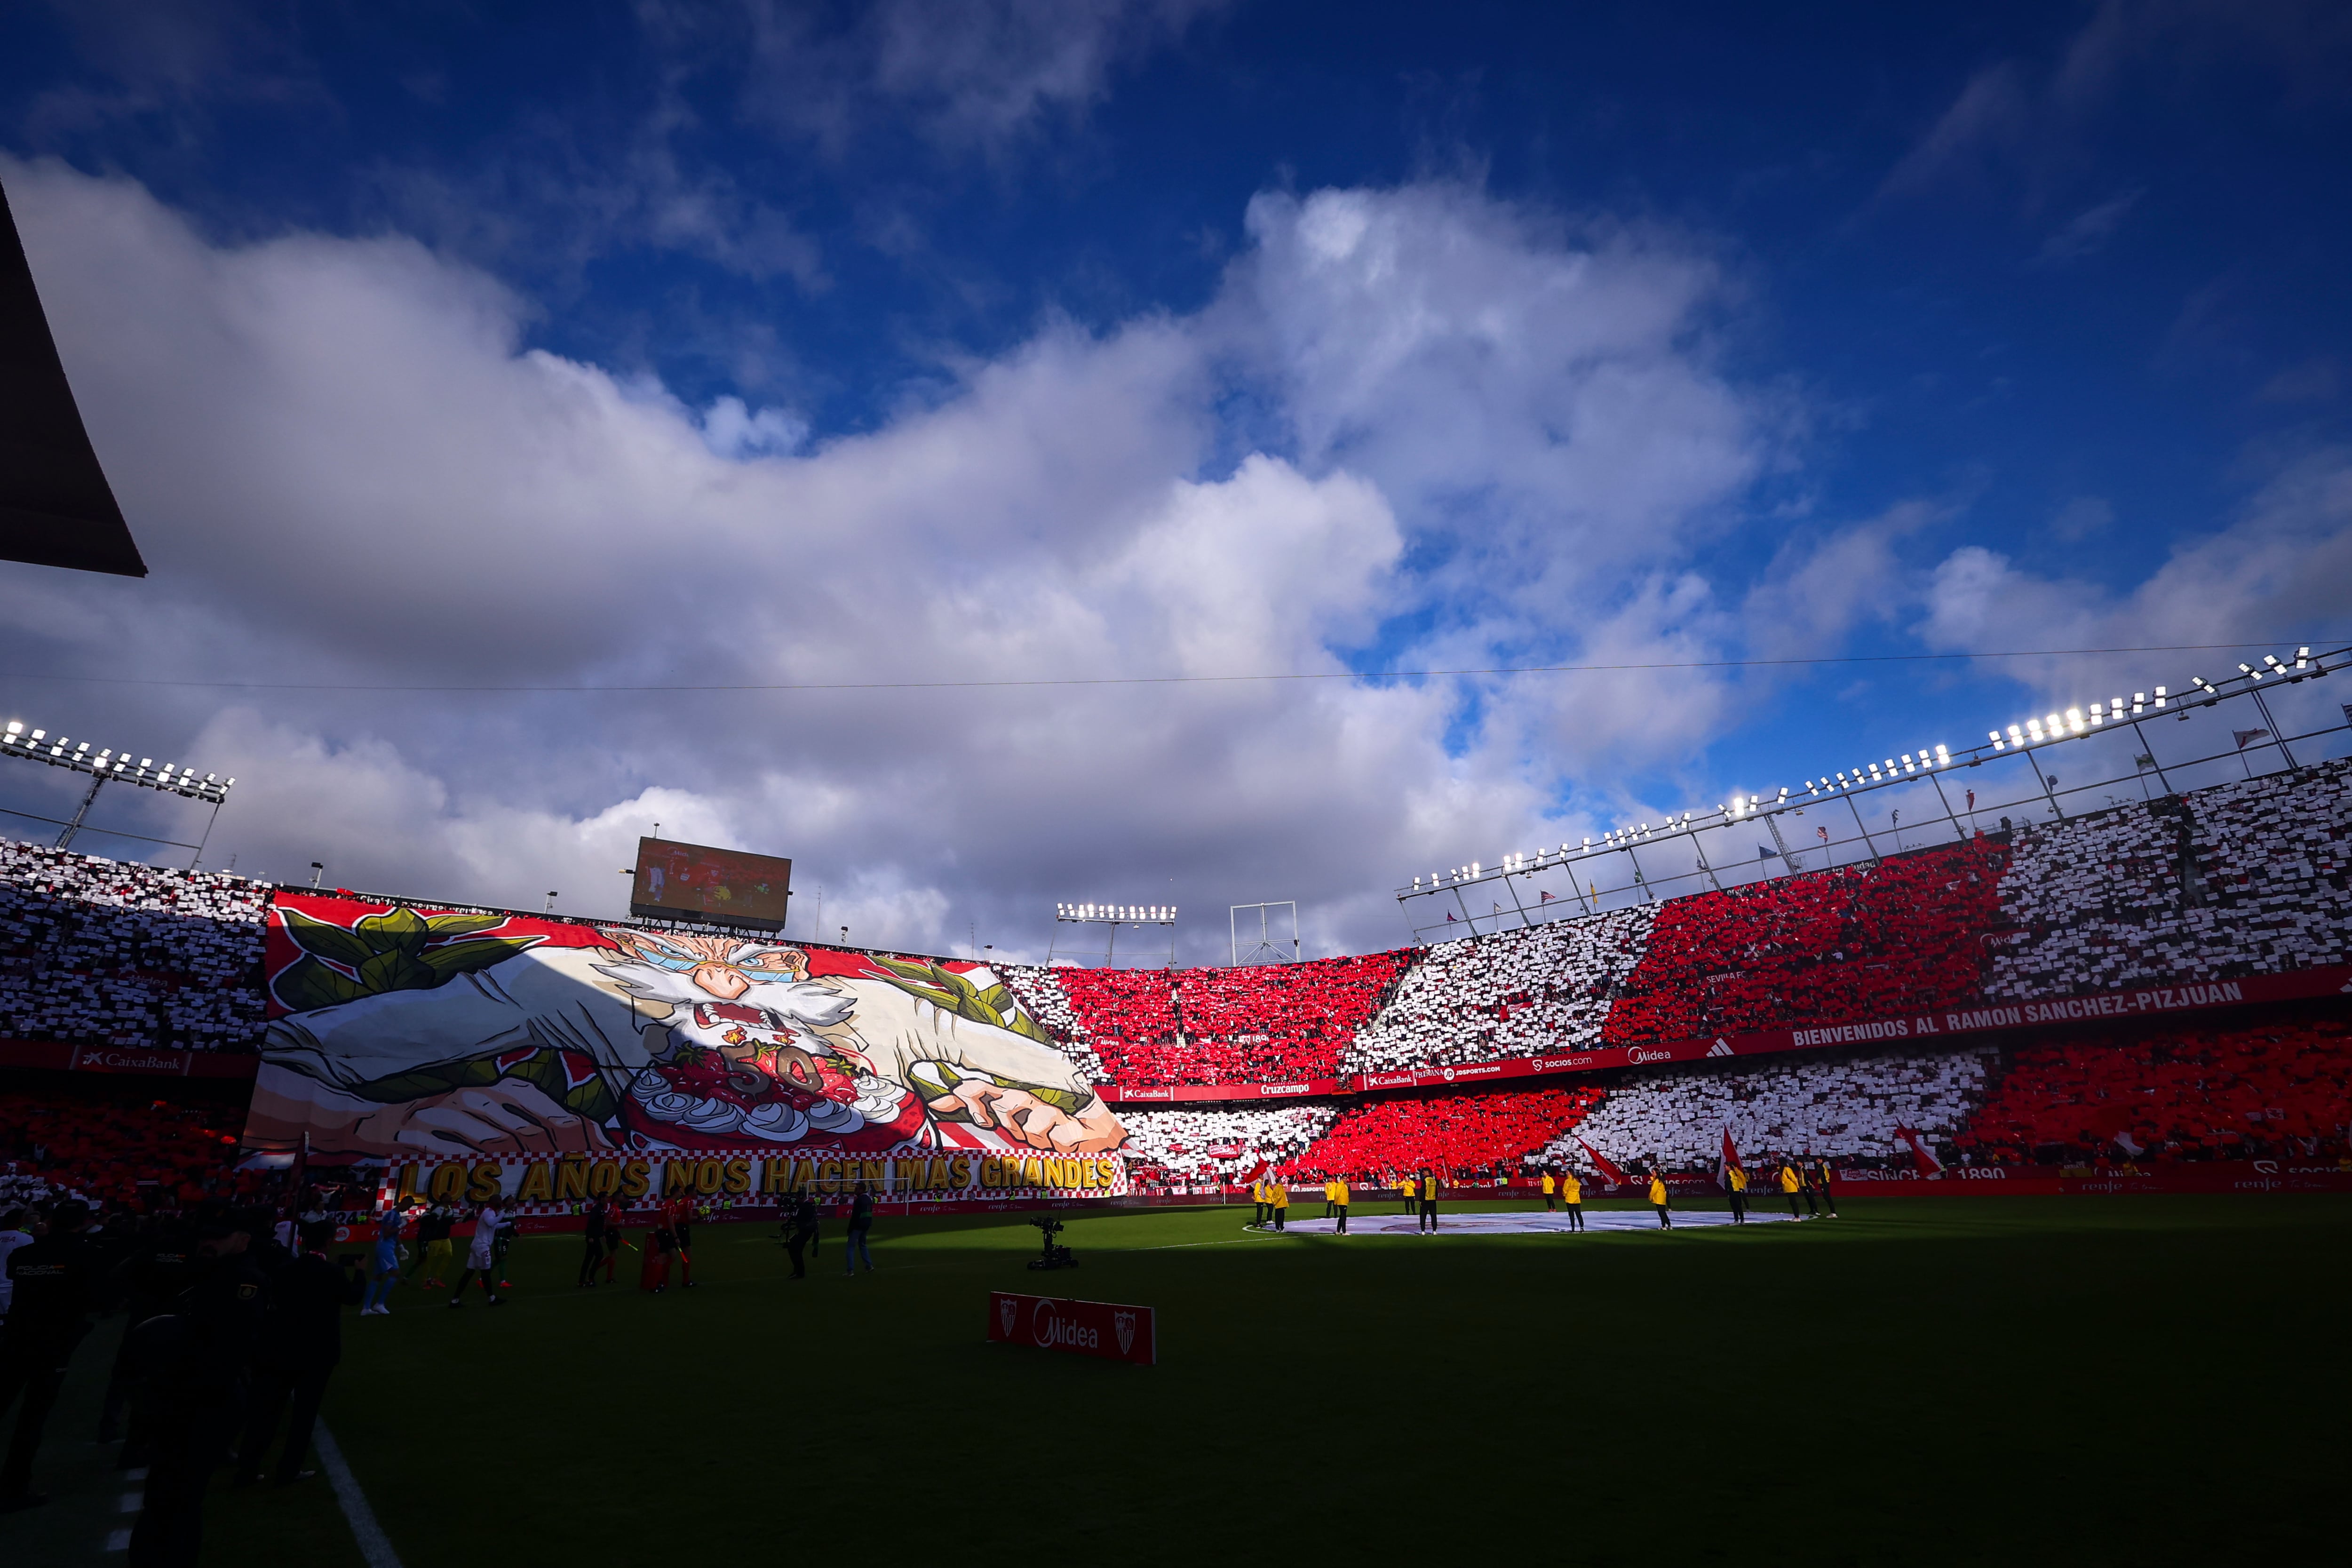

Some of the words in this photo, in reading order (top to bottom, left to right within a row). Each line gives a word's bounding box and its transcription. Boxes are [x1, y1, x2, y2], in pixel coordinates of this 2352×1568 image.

[1849, 859, 1875, 870] iudad
[1792, 1019, 1908, 1046] BIENVENIDOS
[1916, 1017, 1939, 1034] AL
[1946, 1007, 2022, 1031] RAMON
[2024, 982, 2242, 1023] SANCHEZ-PIZJUAN
[105, 1053, 180, 1069] CaixaBank
[1628, 1049, 1671, 1063] Midea
[1545, 1057, 1592, 1068] socios.com
[1455, 1066, 1500, 1076] JDSPORTS.COM
[1379, 1075, 1412, 1085] CaixaBank
[1261, 1084, 1309, 1094] Cruzcampo
[397, 1161, 502, 1205] LOS
[518, 1152, 651, 1202] AÑOS
[661, 1158, 752, 1197] NOS
[763, 1157, 885, 1194] HACEN
[981, 1156, 1114, 1189] GRANDES
[1748, 1185, 1773, 1194] renfe
[2082, 1180, 2122, 1193] renfe
[2235, 1178, 2281, 1192] renfe
[1498, 1189, 1519, 1198] renfe
[920, 1205, 940, 1214] renfe
[988, 1203, 1008, 1212] renfe
[1052, 1201, 1070, 1209] renfe
[1033, 1308, 1098, 1349] Midea
